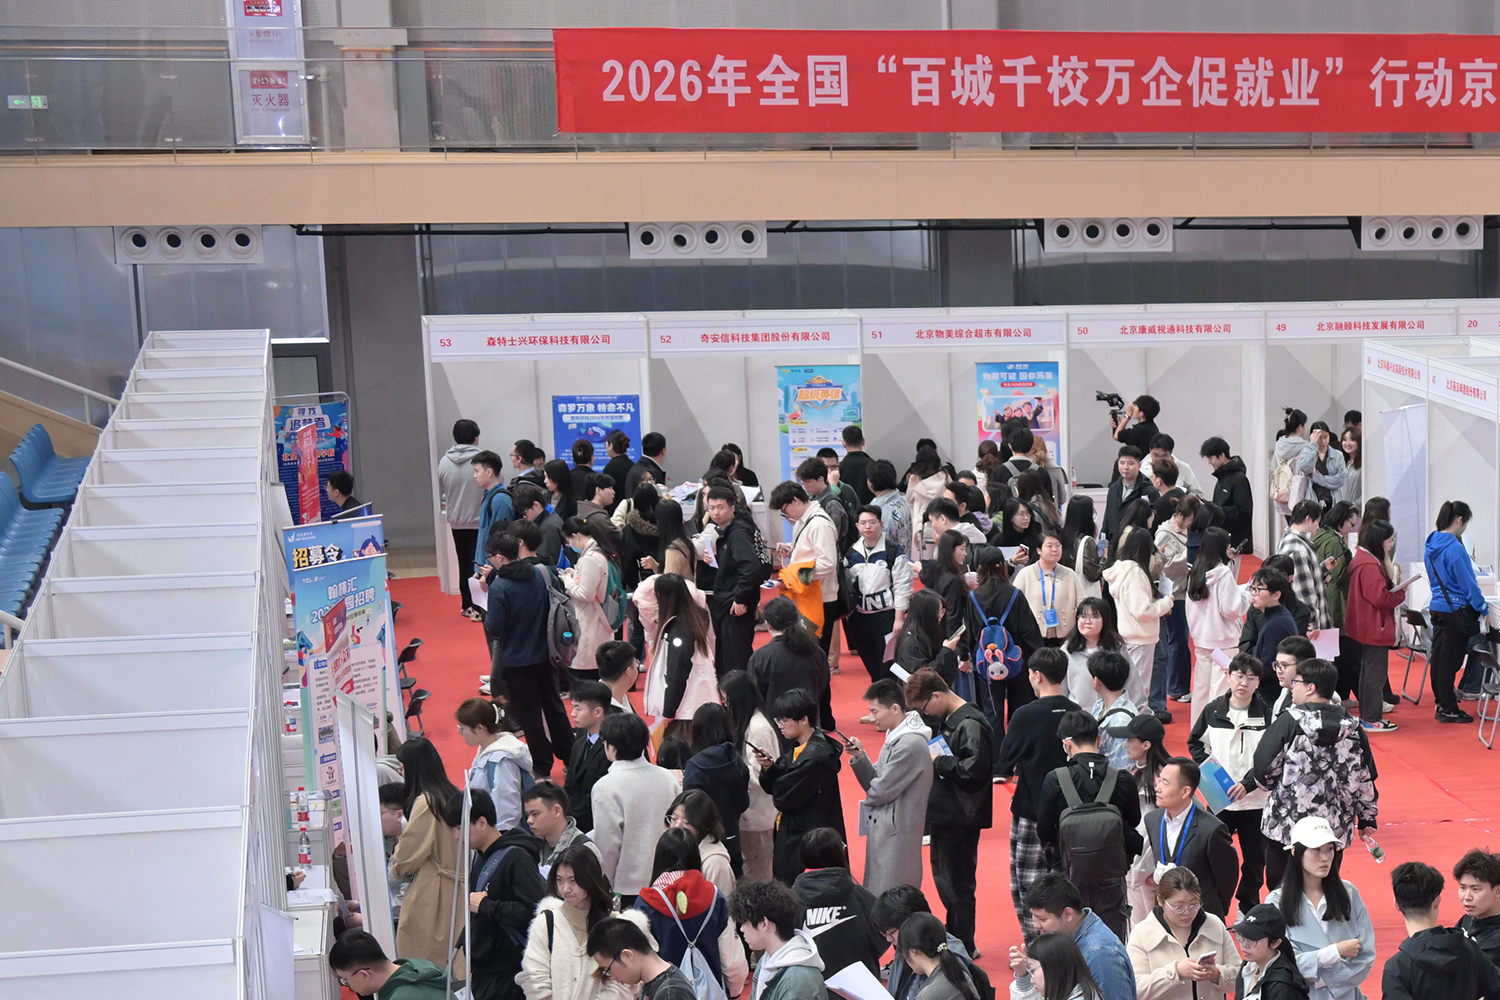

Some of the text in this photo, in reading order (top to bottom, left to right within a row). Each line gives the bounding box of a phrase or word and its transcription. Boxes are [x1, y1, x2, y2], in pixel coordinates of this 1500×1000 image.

[251, 93, 290, 107] 灭火器
[1077, 323, 1232, 335] 50 北京康威视通科技有限公司
[1275, 323, 1287, 332] 49
[1467, 319, 1479, 328] 20
[660, 331, 831, 344] 52 奇安信科技集团股份有限公司
[871, 327, 1032, 339] 51 北京物美综合超市有限公司
[439, 334, 611, 348] 53 森特士兴环保科技有限公司
[291, 543, 342, 568] 招募令
[806, 906, 842, 926] NIKE
